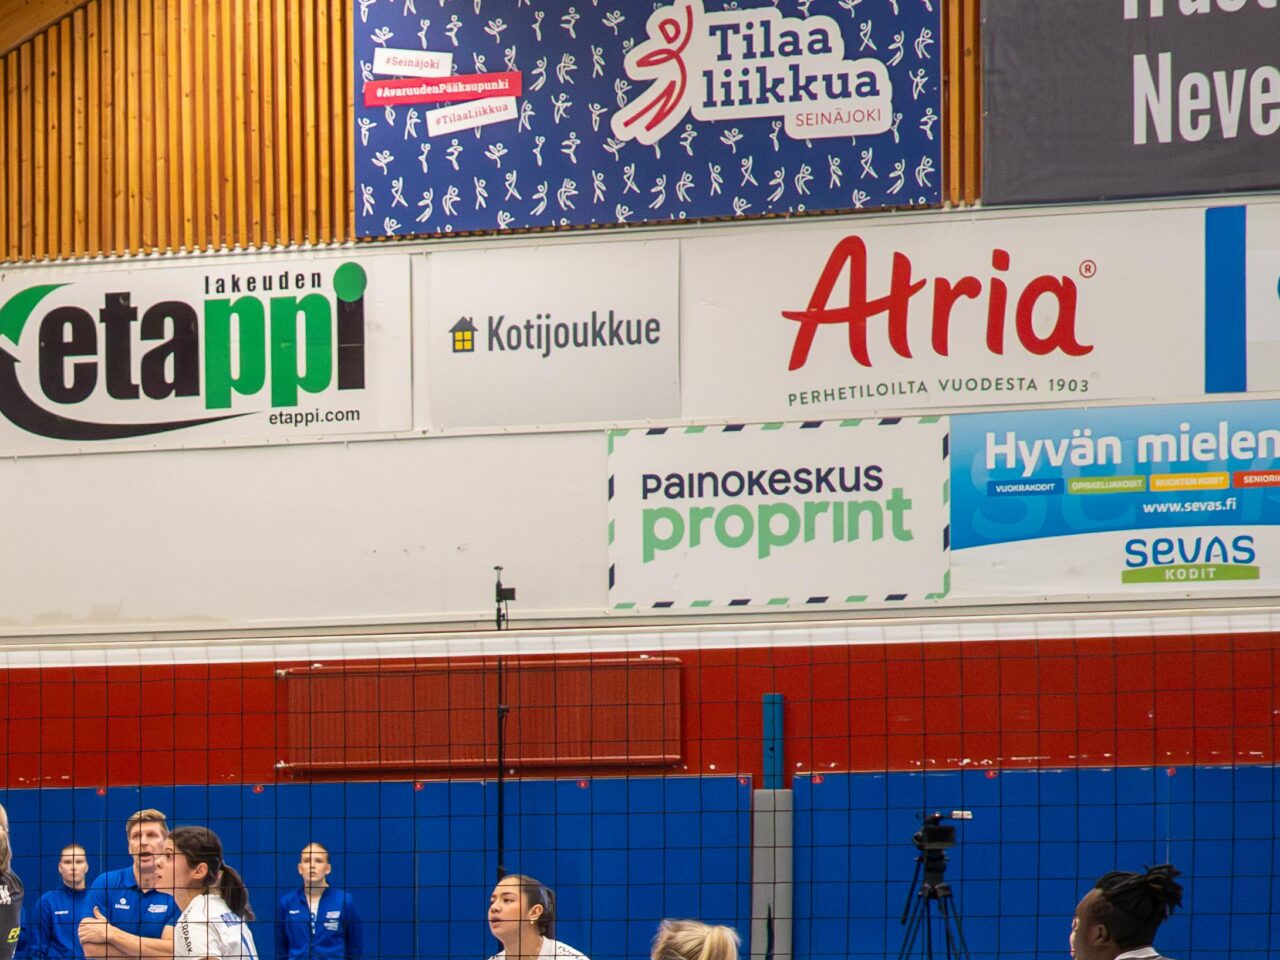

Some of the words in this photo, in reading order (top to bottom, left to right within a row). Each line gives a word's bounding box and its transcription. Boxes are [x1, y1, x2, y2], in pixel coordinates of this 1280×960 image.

[709, 20, 832, 61] Tilaa
[385, 56, 440, 70] #Seinäjoki
[376, 78, 510, 98] #AvaruudenPääkaupunki
[702, 64, 881, 108] liikkua
[1133, 52, 1280, 144] Neve
[435, 103, 509, 126] #TilaaLiikkua
[795, 107, 882, 127] SEINÄJOKI
[204, 271, 322, 294] lakeuden
[781, 235, 1094, 370] Atria
[38, 261, 368, 410] etappi
[487, 310, 662, 358] Kotijoukkue
[788, 380, 929, 407] PERHETILOILTA
[938, 377, 1038, 393] VUODESTA
[1048, 378, 1090, 394] 1903
[268, 407, 362, 428] etappi.com
[985, 427, 1122, 478] Hyvän
[1137, 420, 1280, 463] mielen
[1142, 497, 1237, 514] www.sevas.fi
[641, 487, 915, 564] proprint
[1164, 567, 1217, 580] KODIT
